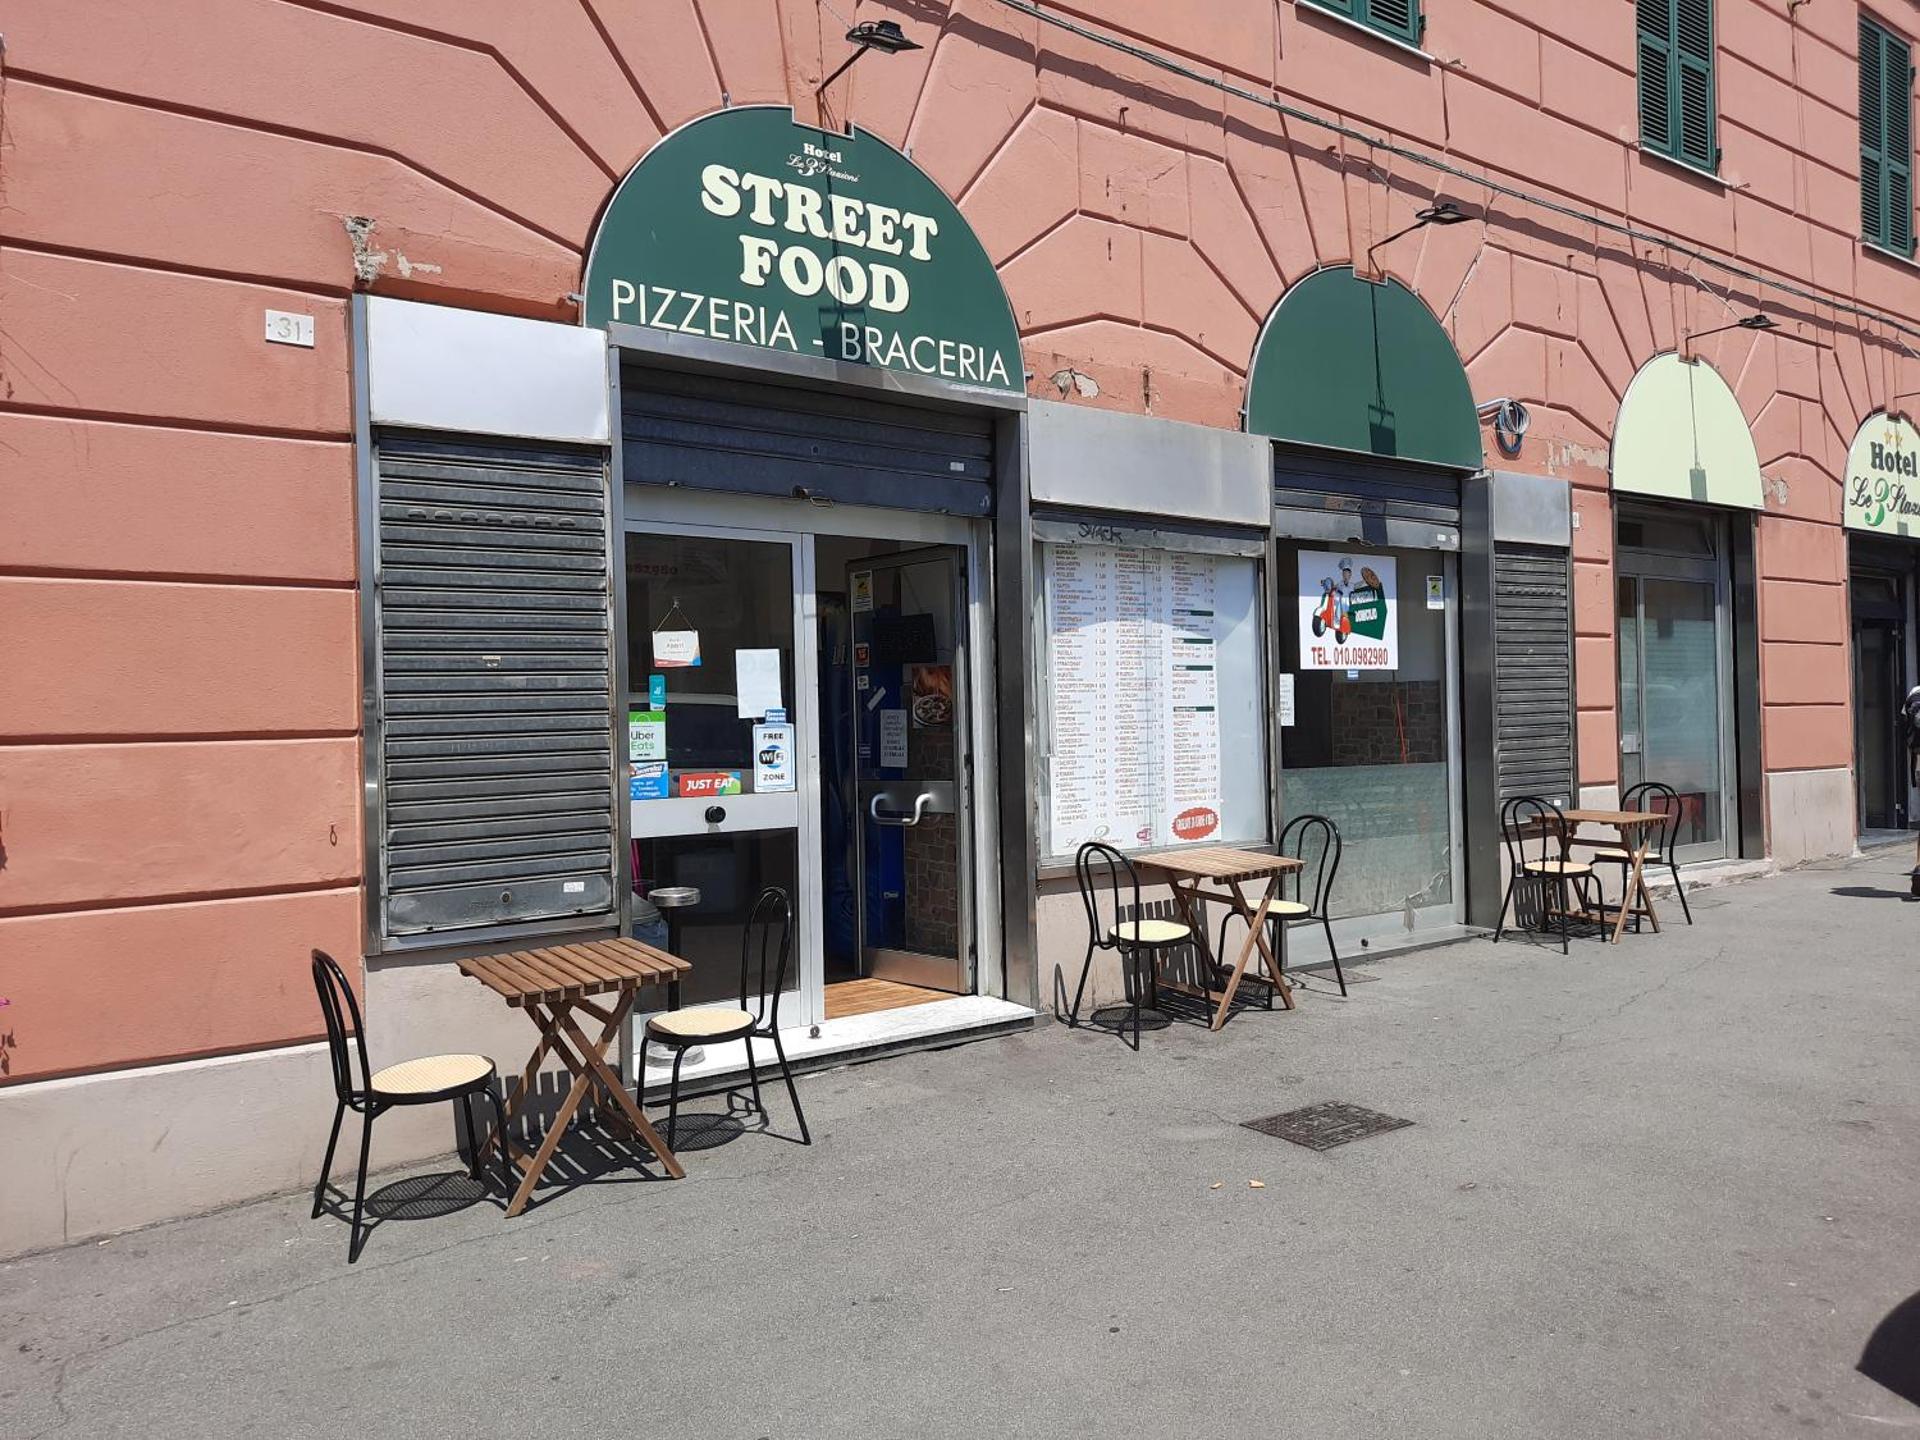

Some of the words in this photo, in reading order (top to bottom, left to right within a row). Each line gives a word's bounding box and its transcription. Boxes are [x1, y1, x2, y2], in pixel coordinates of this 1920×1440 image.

[803, 143, 842, 163] Hotel
[797, 157, 819, 177] 3
[701, 163, 939, 261] STREET
[738, 234, 910, 313] FOOD
[277, 316, 300, 342] 31
[612, 279, 798, 351] PIZZERIA
[841, 322, 1011, 386] BRACERIA
[1870, 441, 1918, 478] Hotel
[1849, 476, 1872, 509] Le
[1864, 477, 1890, 527] 3
[1311, 646, 1331, 665] TEL.
[1333, 646, 1389, 666] 010.0982980
[630, 730, 655, 741] Uber
[630, 740, 655, 751] Eats
[763, 732, 784, 740] FREE
[686, 778, 711, 792] JUST
[714, 776, 735, 789] EAT
[763, 773, 786, 781] ZONE
